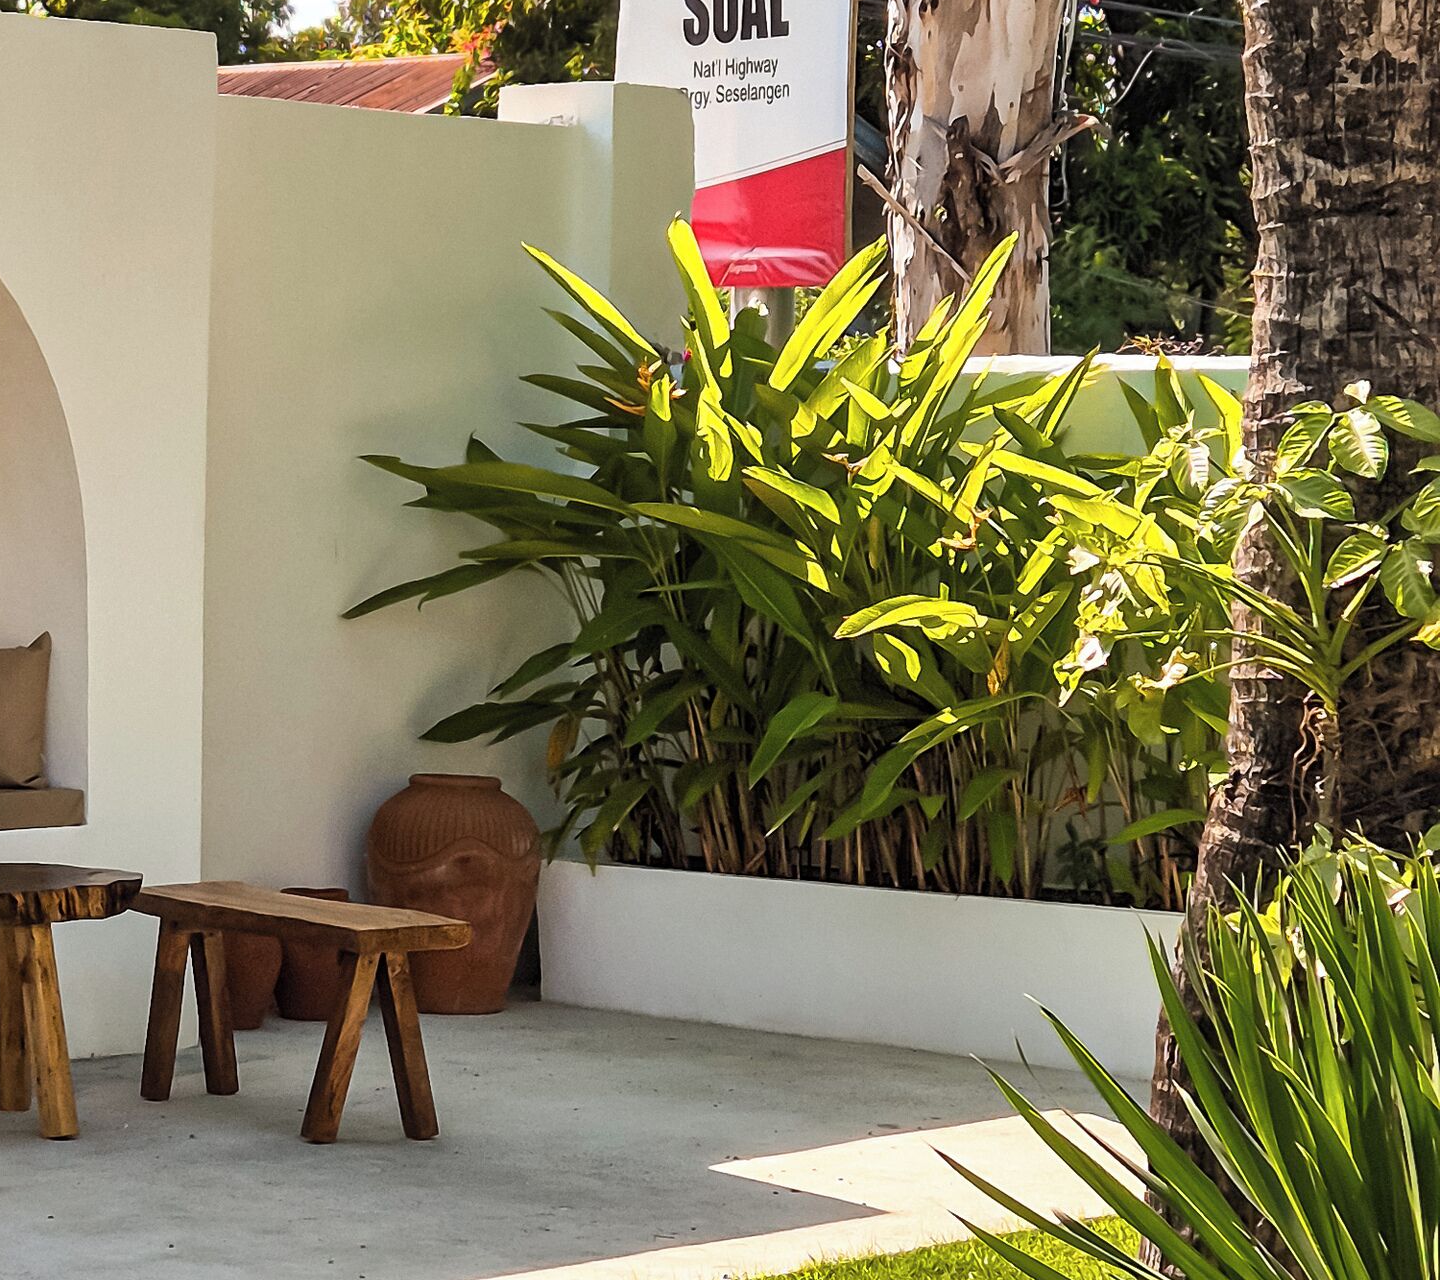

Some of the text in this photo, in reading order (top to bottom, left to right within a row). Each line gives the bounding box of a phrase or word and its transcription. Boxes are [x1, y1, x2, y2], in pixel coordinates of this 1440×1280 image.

[693, 56, 779, 81] Nat'l Highway
[715, 83, 790, 105] Seselangen
